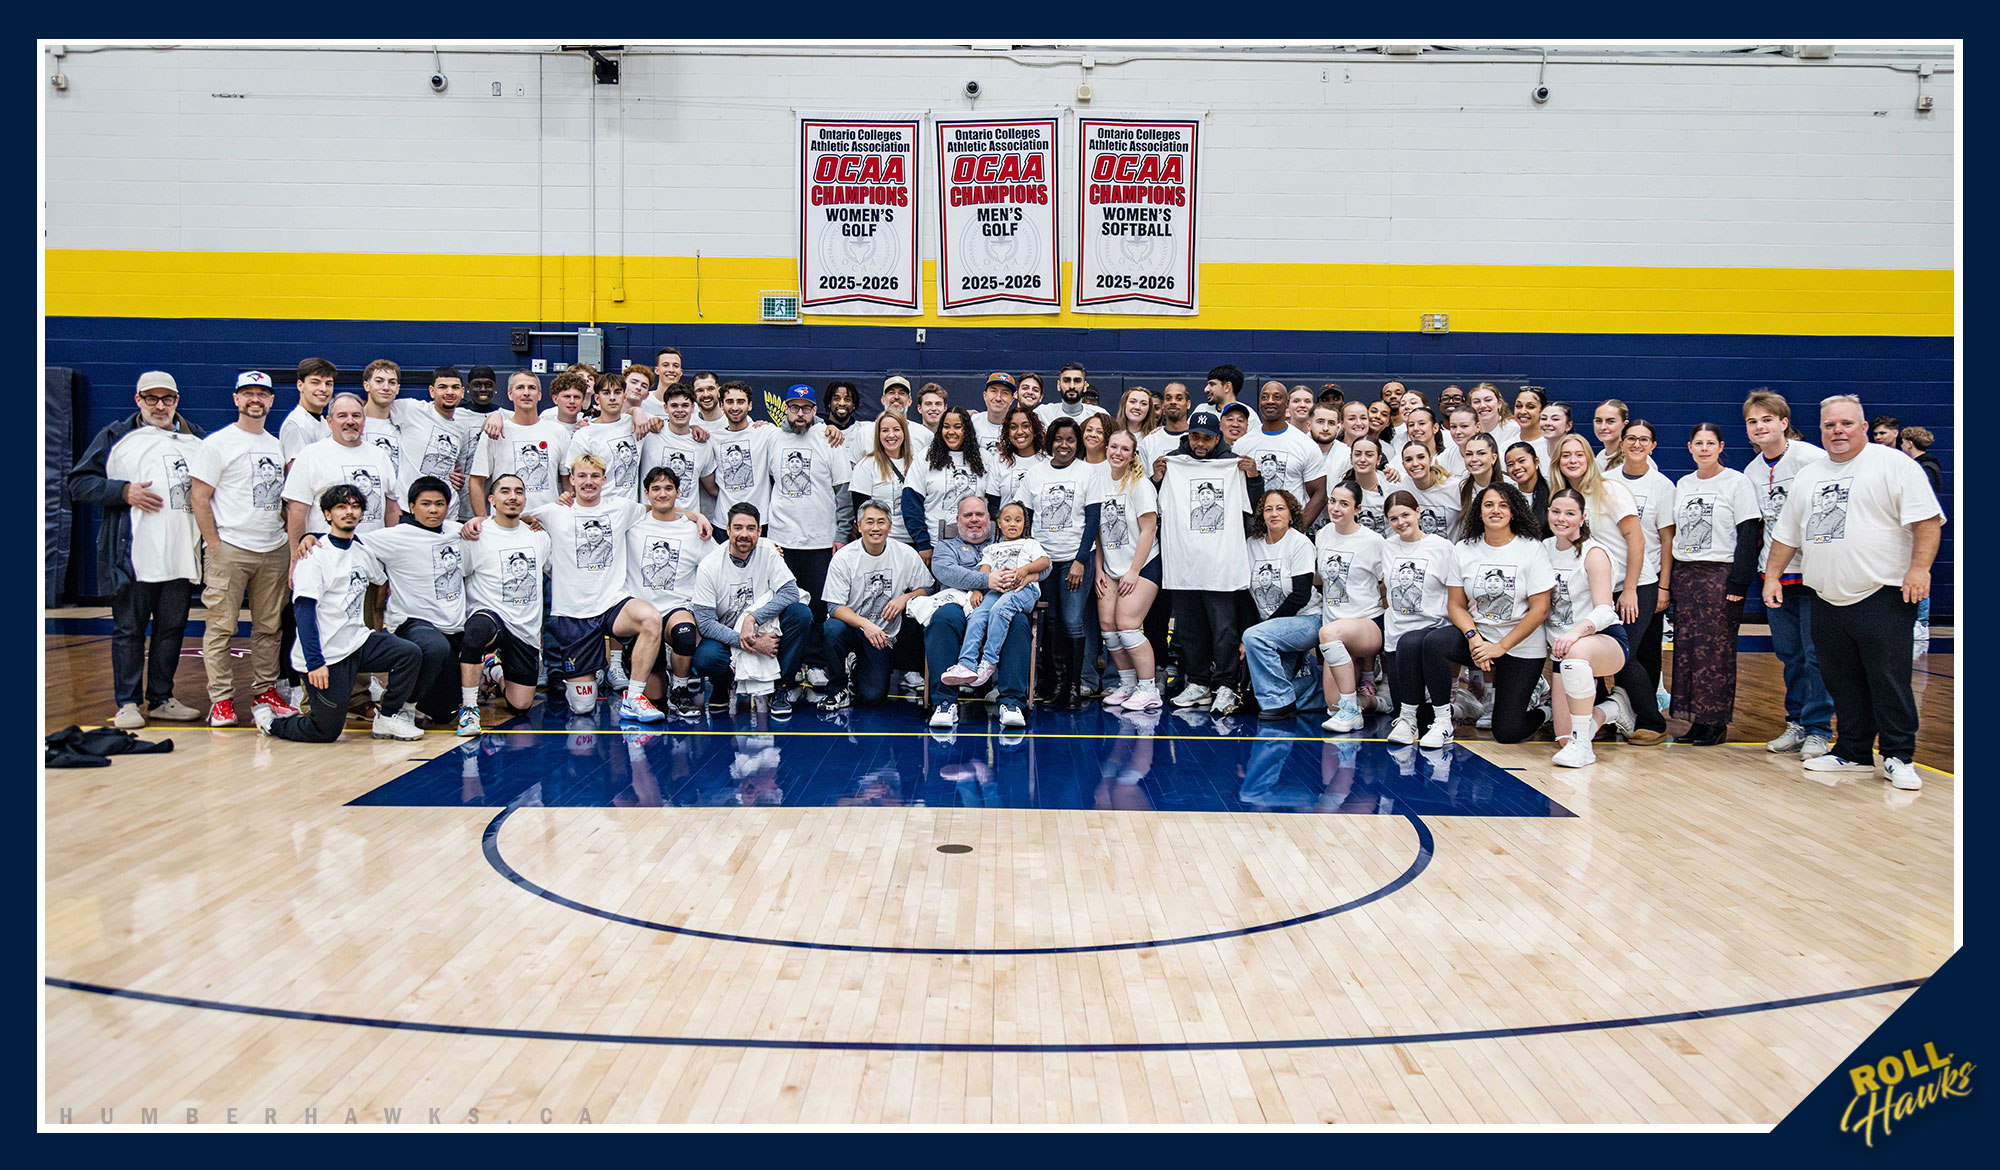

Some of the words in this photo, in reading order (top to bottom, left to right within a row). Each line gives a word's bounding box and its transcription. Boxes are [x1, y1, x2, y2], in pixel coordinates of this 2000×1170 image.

[820, 129, 856, 140] Ontario
[858, 129, 902, 142] Colleges
[955, 129, 993, 140] Ontario
[995, 128, 1040, 140] Colleges
[1098, 128, 1134, 140] Ontario
[1136, 129, 1181, 141] Colleges
[811, 140, 850, 152] Athletic
[851, 141, 910, 152] Association
[947, 141, 987, 152] Athletic
[989, 139, 1049, 151] Association
[1089, 139, 1128, 151] Athletic
[1129, 141, 1189, 152] Association
[813, 154, 905, 184] OCAA
[951, 152, 1045, 184] OCAA
[1091, 153, 1183, 184] OCAA
[811, 185, 908, 207] CHAMPIONS
[950, 185, 1048, 207] CHAMPIONS
[1089, 184, 1185, 207] CHAMPIONS
[826, 208, 894, 222] WOMEN’S
[977, 207, 1023, 221] MEN’S
[1103, 207, 1172, 222] WOMEN’S
[842, 223, 877, 237] GOLF
[982, 223, 1018, 236] GOLF
[1101, 222, 1172, 236] SOFTBALL
[819, 276, 899, 289] 2025-2026
[962, 275, 1041, 289] 2025-2026
[1096, 275, 1175, 289] 2025-2026
[576, 685, 592, 695] CAN
